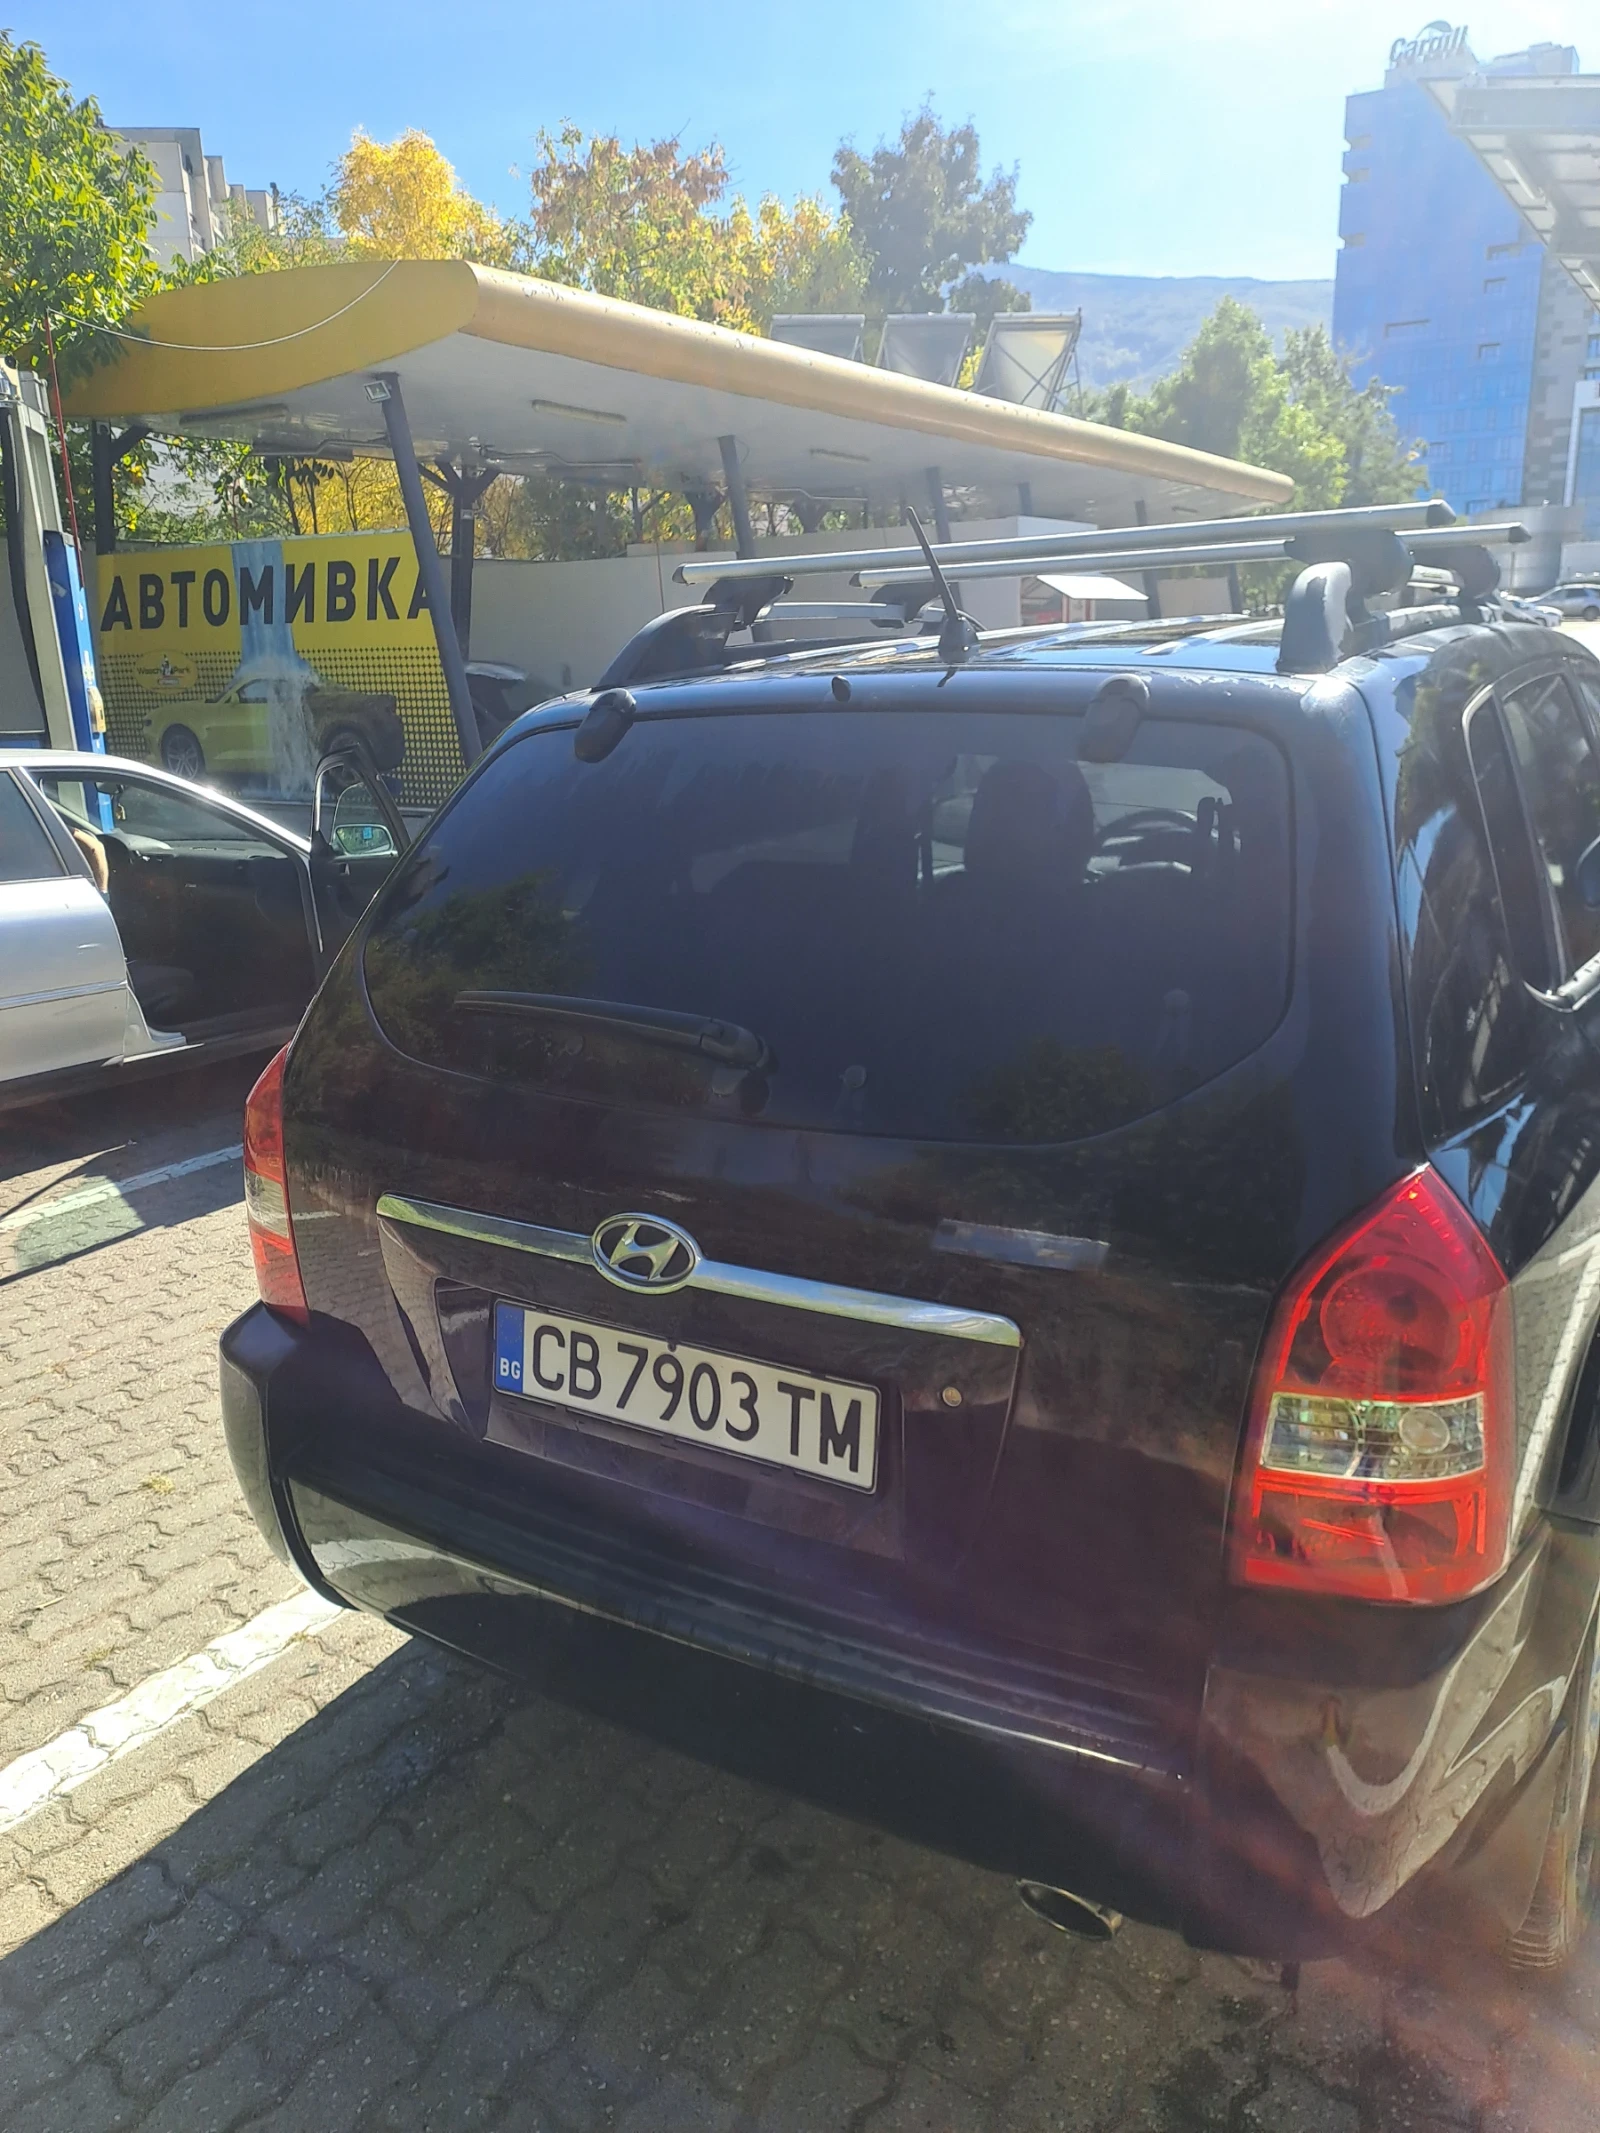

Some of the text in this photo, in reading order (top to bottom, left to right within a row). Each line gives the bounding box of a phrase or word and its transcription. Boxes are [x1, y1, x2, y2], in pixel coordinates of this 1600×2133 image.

[1389, 24, 1469, 63] Cargill
[500, 1357, 521, 1380] BG
[532, 1325, 862, 1474] CB 7903 TM
